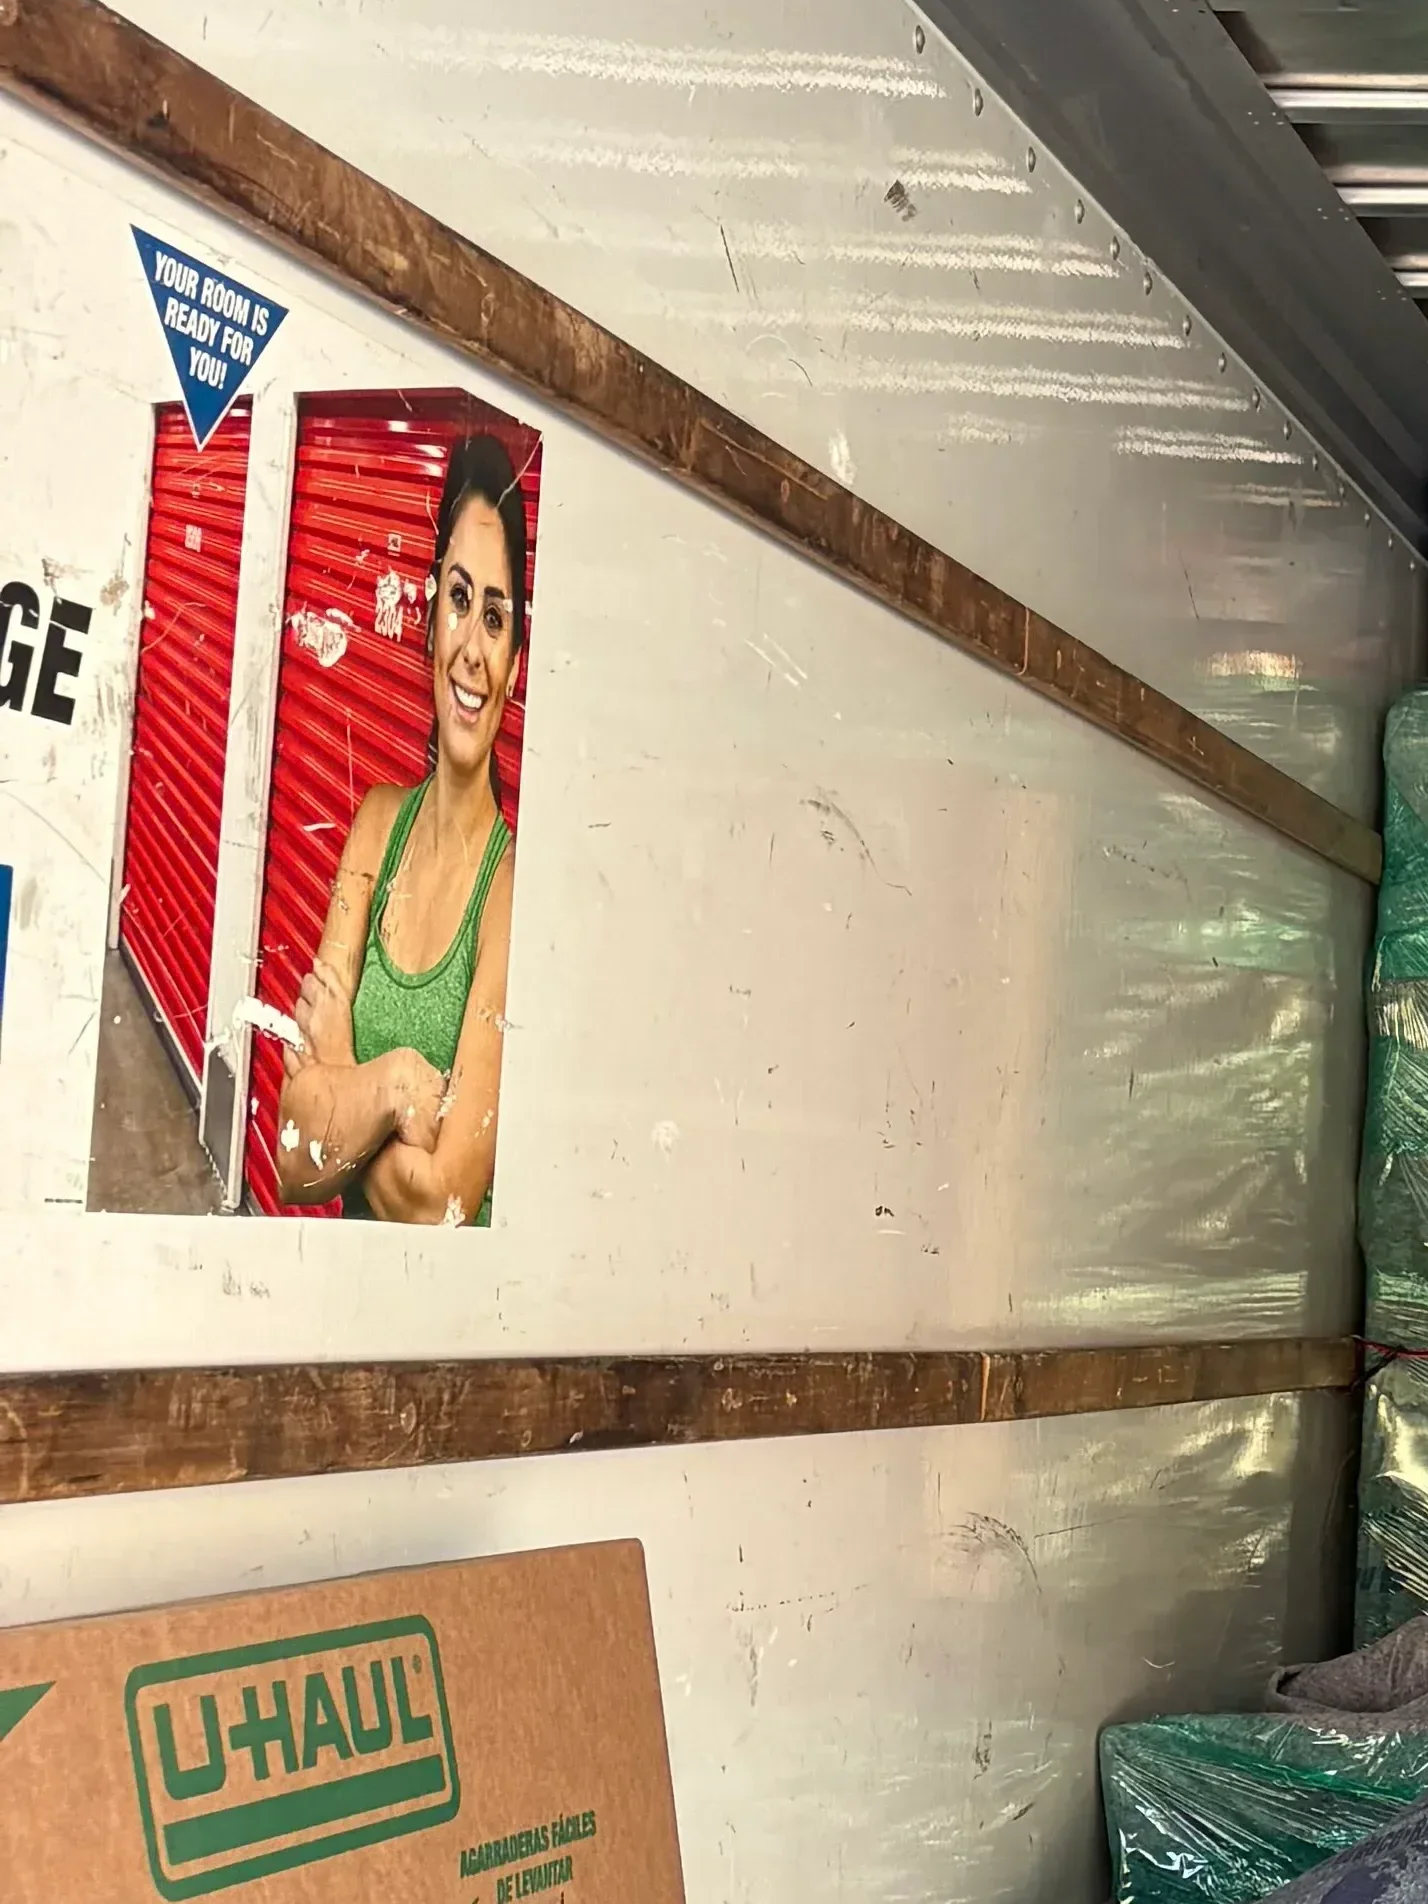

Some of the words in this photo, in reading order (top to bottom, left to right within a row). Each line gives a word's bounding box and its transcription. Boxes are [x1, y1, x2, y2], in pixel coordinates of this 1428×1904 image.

[155, 250, 199, 299] YOUR
[200, 276, 250, 327] ROOM
[251, 303, 270, 336] IS
[164, 296, 220, 347] READY
[220, 326, 254, 366] FOR
[189, 346, 228, 390] YOU!
[153, 1656, 434, 1800] U-HAUL
[460, 1825, 549, 1879] AGARRADERAS
[551, 1810, 596, 1847] FÁCILES
[515, 1855, 573, 1899] LEVANTAR
